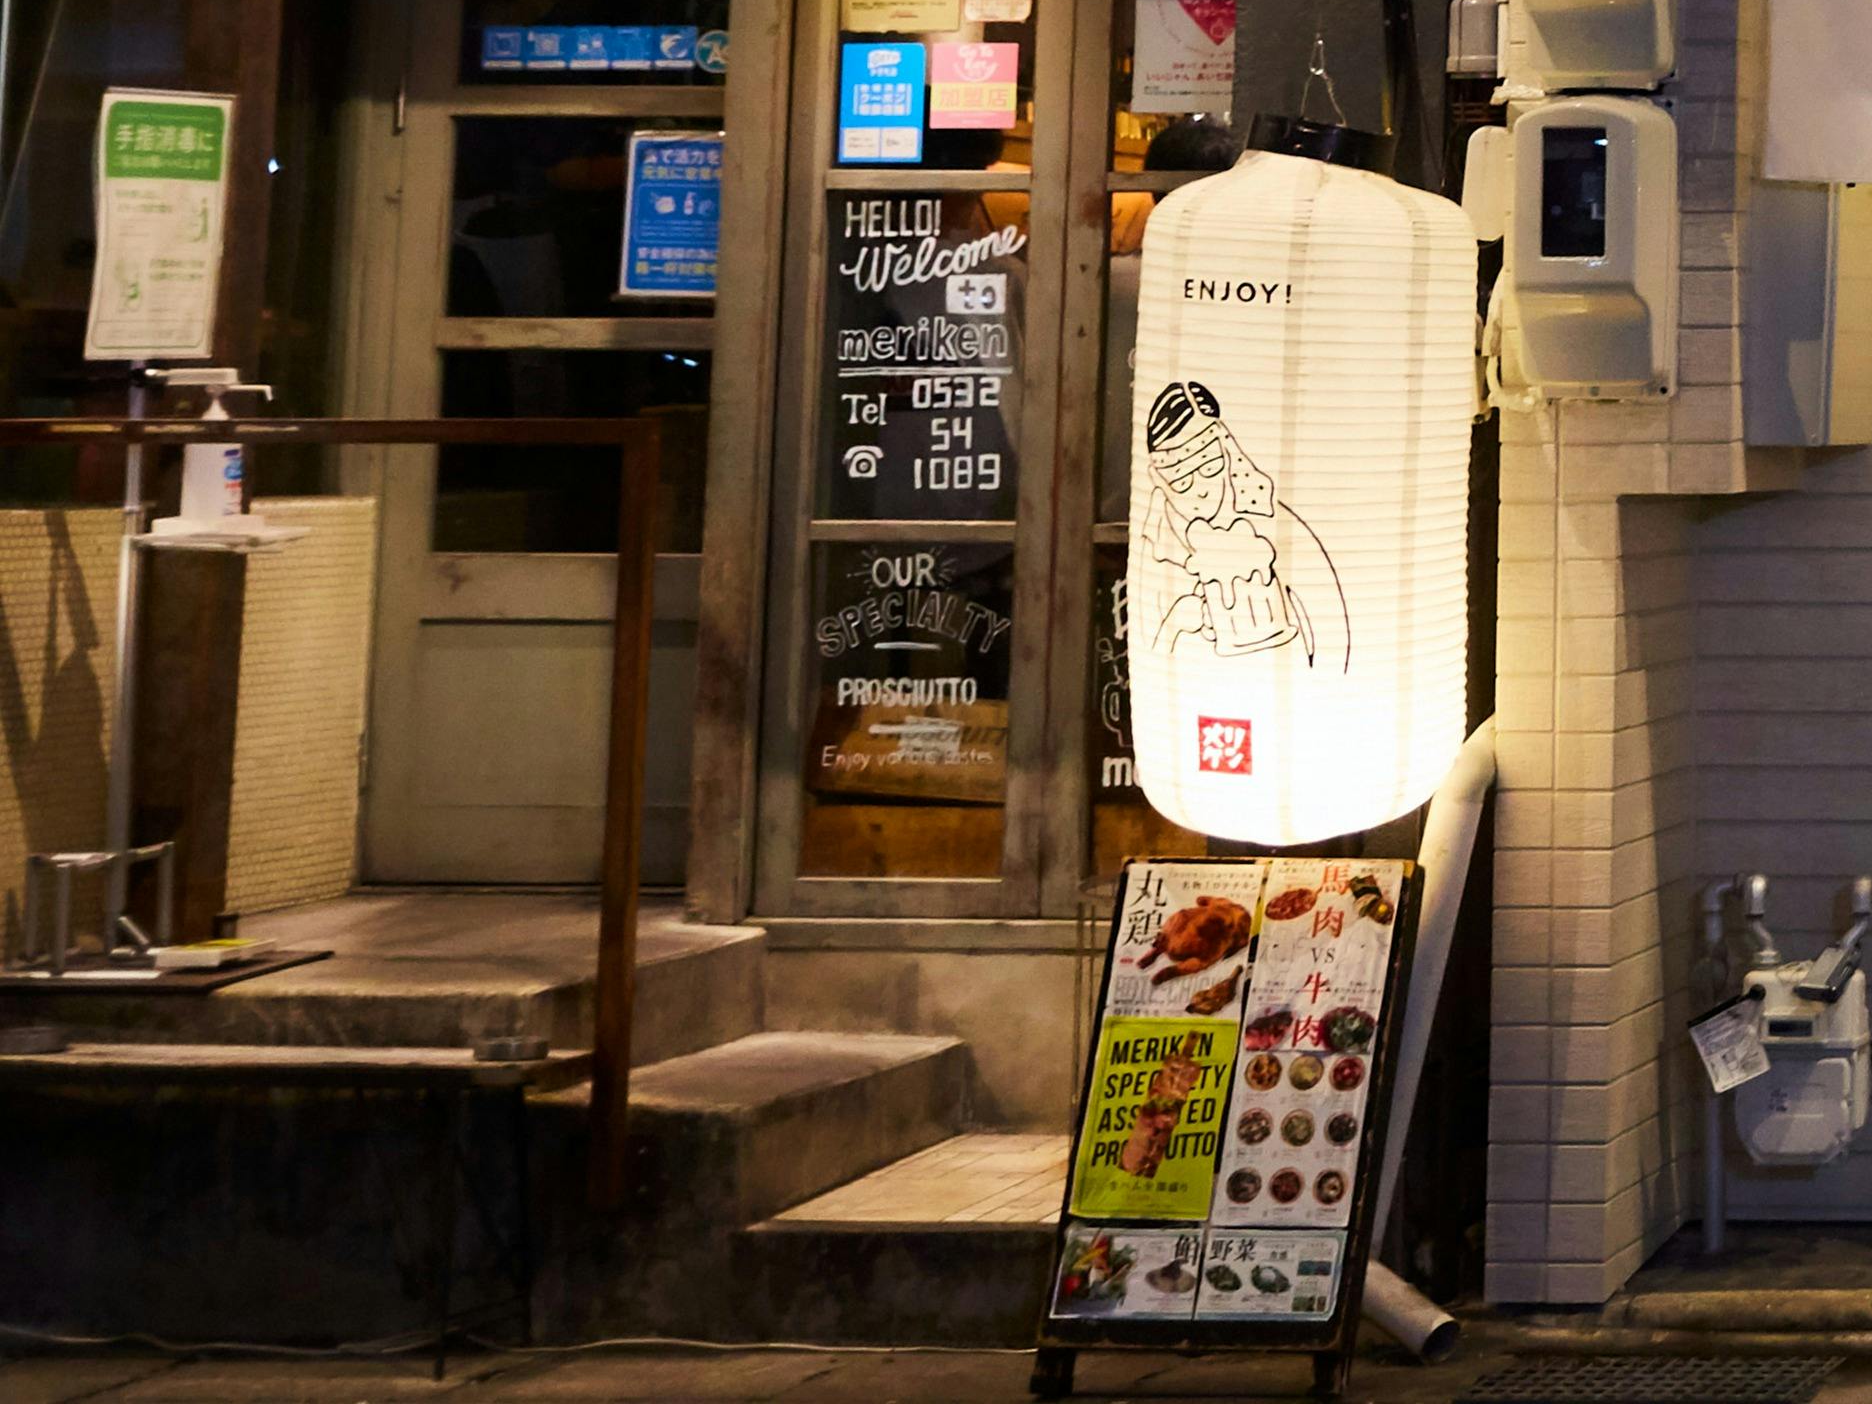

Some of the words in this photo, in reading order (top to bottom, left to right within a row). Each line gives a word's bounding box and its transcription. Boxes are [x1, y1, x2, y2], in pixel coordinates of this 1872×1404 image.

[845, 199, 942, 238] HELLO!
[839, 224, 1027, 293] Welcome
[957, 278, 997, 310] to
[1183, 278, 1292, 305] ENJOY!
[837, 316, 1009, 362] meriken
[841, 392, 888, 426] Tel
[911, 376, 1001, 409] 0532
[930, 416, 973, 452] 54
[913, 453, 1001, 490] 1089
[871, 551, 938, 588] OUR
[815, 589, 1012, 658] SPECIALTY
[837, 676, 979, 708] PROSCIUTTO
[820, 745, 872, 771] Enjoy
[1110, 1032, 1214, 1066] MERIKN
[1091, 1131, 1217, 1168] PRUTTO
